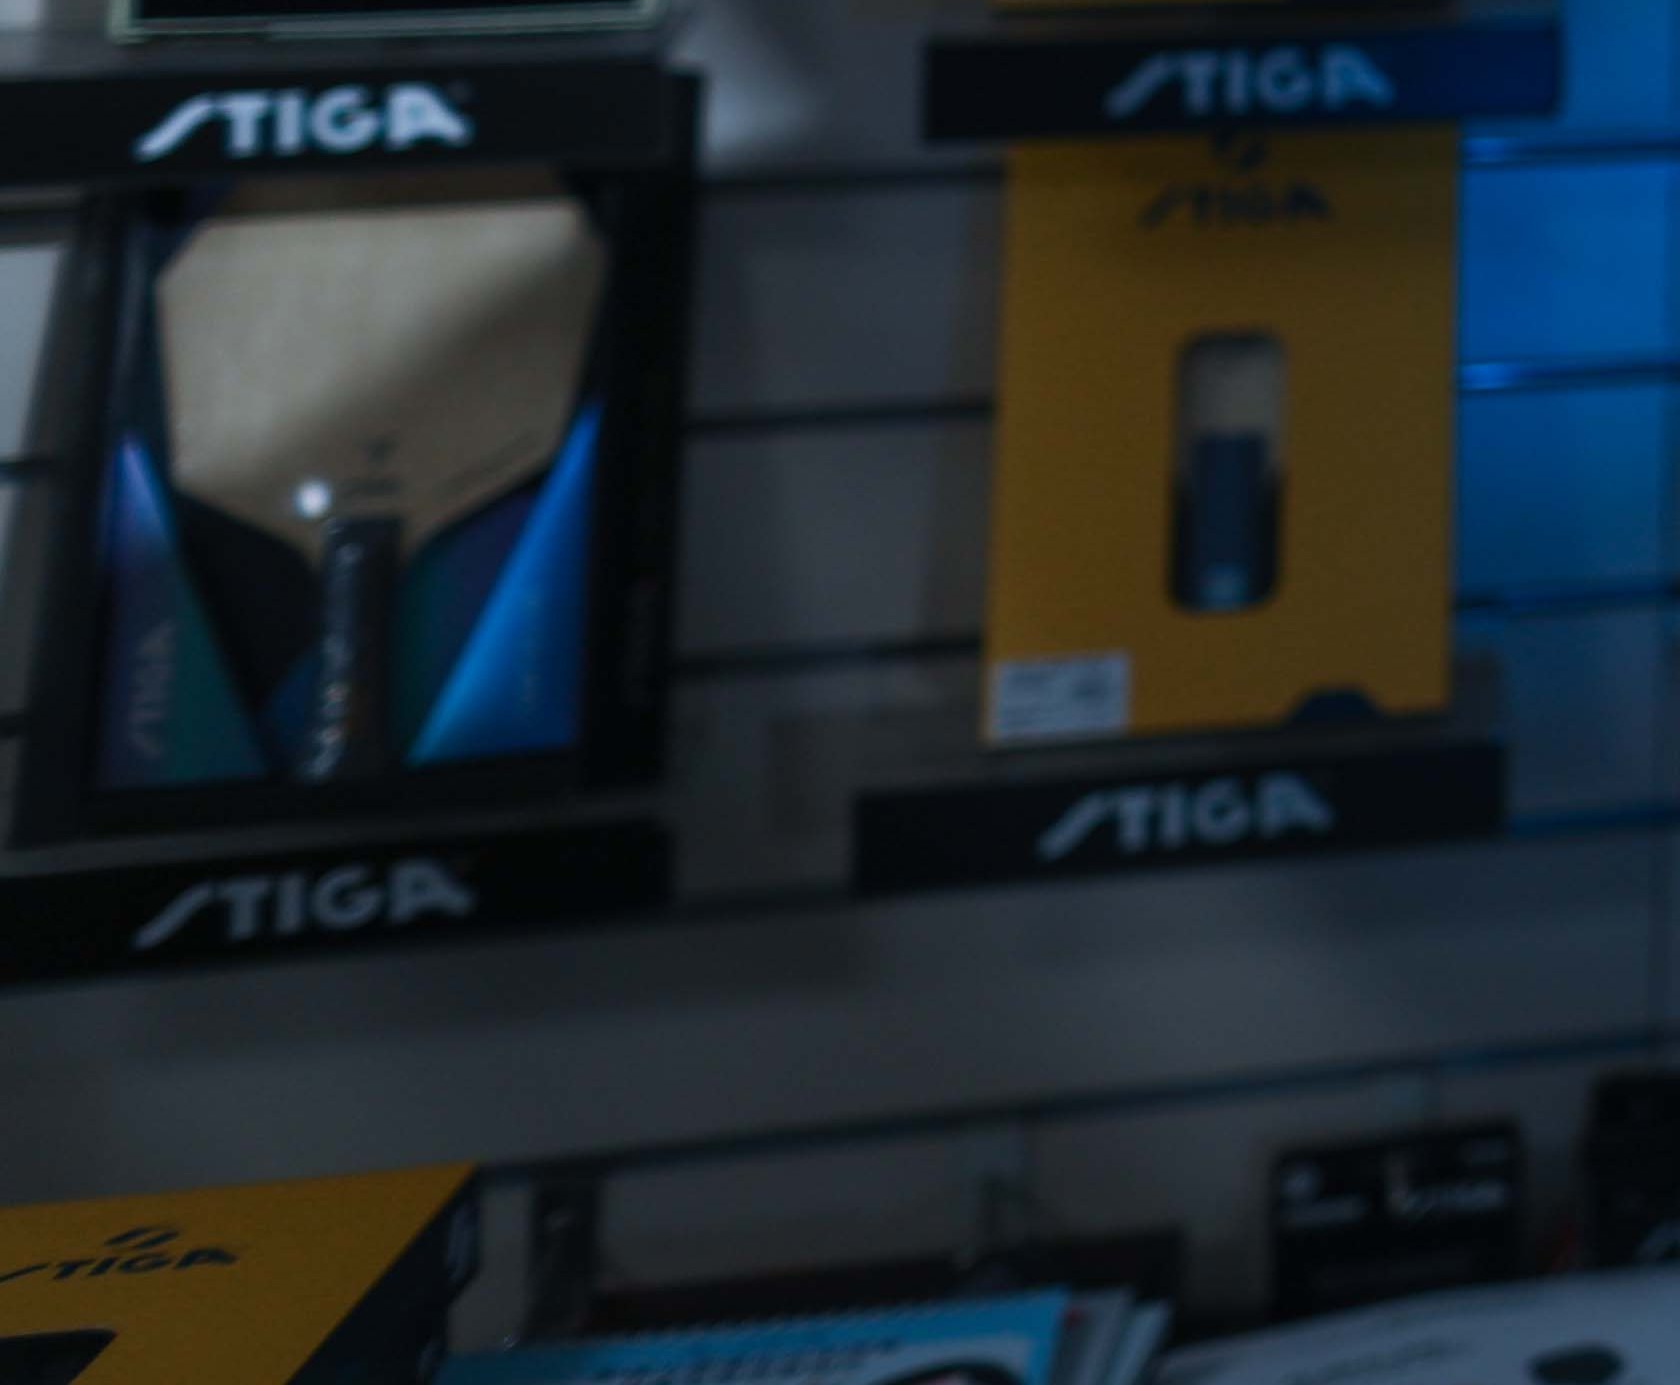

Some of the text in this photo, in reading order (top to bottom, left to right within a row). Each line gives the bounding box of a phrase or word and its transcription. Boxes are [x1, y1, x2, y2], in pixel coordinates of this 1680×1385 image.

[1105, 44, 1397, 118] STIGA
[134, 82, 474, 165] STIGA
[1036, 772, 1335, 861] STIGA
[130, 857, 478, 951] STIGA
[0, 1244, 242, 1283] STIGA
